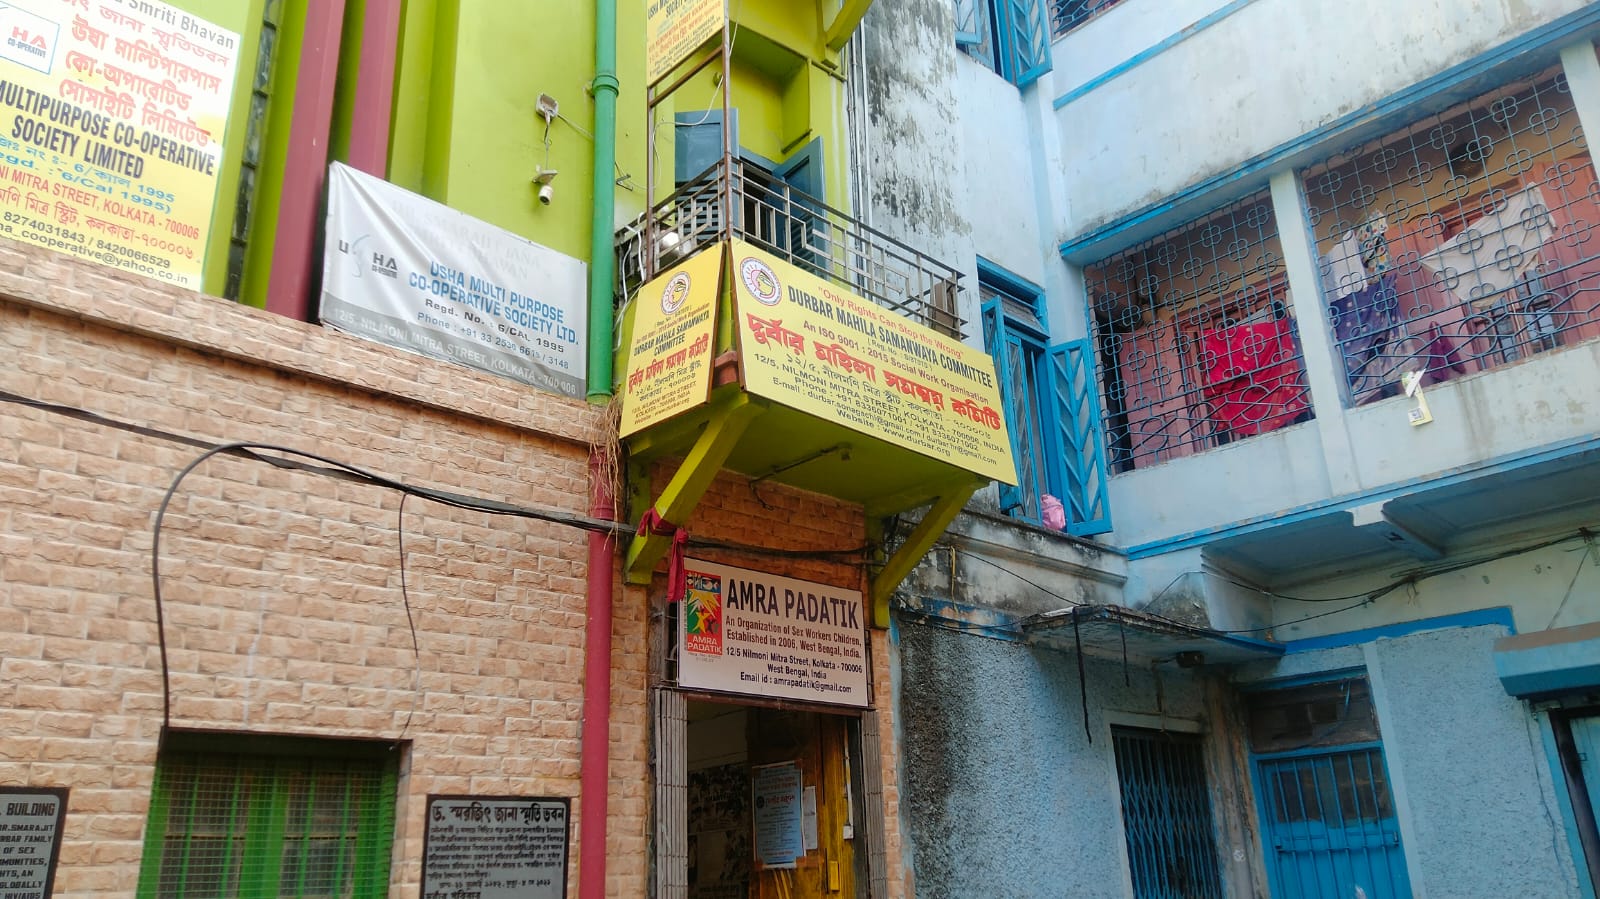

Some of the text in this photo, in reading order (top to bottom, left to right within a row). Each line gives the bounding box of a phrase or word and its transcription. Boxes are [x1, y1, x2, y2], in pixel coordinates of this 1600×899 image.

[100, 5, 146, 33] জানা
[129, 0, 235, 49] Smriti Bhavan
[12, 26, 47, 50] HA
[72, 14, 222, 94] উষা মাল্টিপারপাস
[12, 114, 144, 179] SOCIETY LIMITED
[113, 121, 215, 177] CO-OPERATIVE
[12, 168, 200, 240] MITRA STREET, KOLKATA 700006
[137, 184, 175, 203] 1995
[3, 210, 171, 269] 8274031843 8420066529
[372, 252, 398, 271] HA
[430, 260, 465, 289] USHA
[469, 275, 506, 303] MULTI
[510, 290, 564, 324] PURPOSE
[408, 271, 501, 317] CO-OPERATIVE
[504, 306, 553, 336] SOCIETY
[556, 325, 580, 346] LTD.
[424, 298, 459, 317] Regd.
[464, 311, 486, 325] No.
[535, 337, 565, 354] 1995
[847, 300, 878, 321] Rights
[879, 314, 897, 328] Can
[899, 323, 919, 340] Stop
[919, 333, 934, 346] the
[417, 311, 569, 370] Phone +91 33 3148
[653, 332, 686, 357] COMMITTEE
[787, 285, 834, 321] DURBAR
[836, 306, 877, 339] MAHILA
[878, 325, 939, 366] SAMANWAYA
[940, 353, 993, 390] COMMITTEE
[491, 358, 537, 382] KOLKATA
[746, 312, 806, 356] দুর্বার
[812, 340, 877, 385] মহিলা
[882, 369, 945, 412] সমন্বয়
[949, 396, 1001, 430] কমিটি
[803, 320, 816, 334] An
[818, 326, 836, 341] ISO
[837, 334, 860, 351] 9001
[867, 347, 889, 363] 2015
[890, 356, 918, 375] Social
[918, 367, 940, 385] Work
[940, 377, 990, 406] Organisation
[772, 376, 801, 393] E-mail
[794, 376, 828, 395] Phone
[836, 392, 852, 404] +91
[753, 353, 781, 370] 12/5,
[782, 363, 827, 387] NILMONI
[829, 381, 861, 402] MITRA
[862, 395, 903, 416] STREET,
[903, 410, 946, 432] KOLKATA
[983, 440, 1006, 455] INDIA
[836, 408, 875, 429] Website
[726, 579, 779, 617] AMRA
[783, 589, 859, 630] PADATIK
[692, 635, 718, 646] AMRA
[725, 615, 862, 647] An Organization of Sex Workers Children,
[727, 629, 768, 645] Established
[769, 635, 777, 646] in
[778, 637, 798, 651] 2006,
[799, 640, 816, 652] West
[817, 643, 842, 657] Bengal,
[687, 642, 722, 655] PADATIK
[742, 648, 769, 661] Nilmoni
[770, 652, 788, 664] Mitra
[789, 655, 811, 668] Street,
[812, 658, 836, 671] Kolkata
[840, 662, 863, 674] 700006
[740, 671, 852, 693] Email id amrapadatik@gmail.com
[767, 663, 827, 680] West Bengal, India
[6, 802, 57, 817] BUILDING
[432, 802, 565, 825] ড. স্মরজিৎ জানা স্মৃতি ভবন
[3, 846, 36, 854] OF SEX
